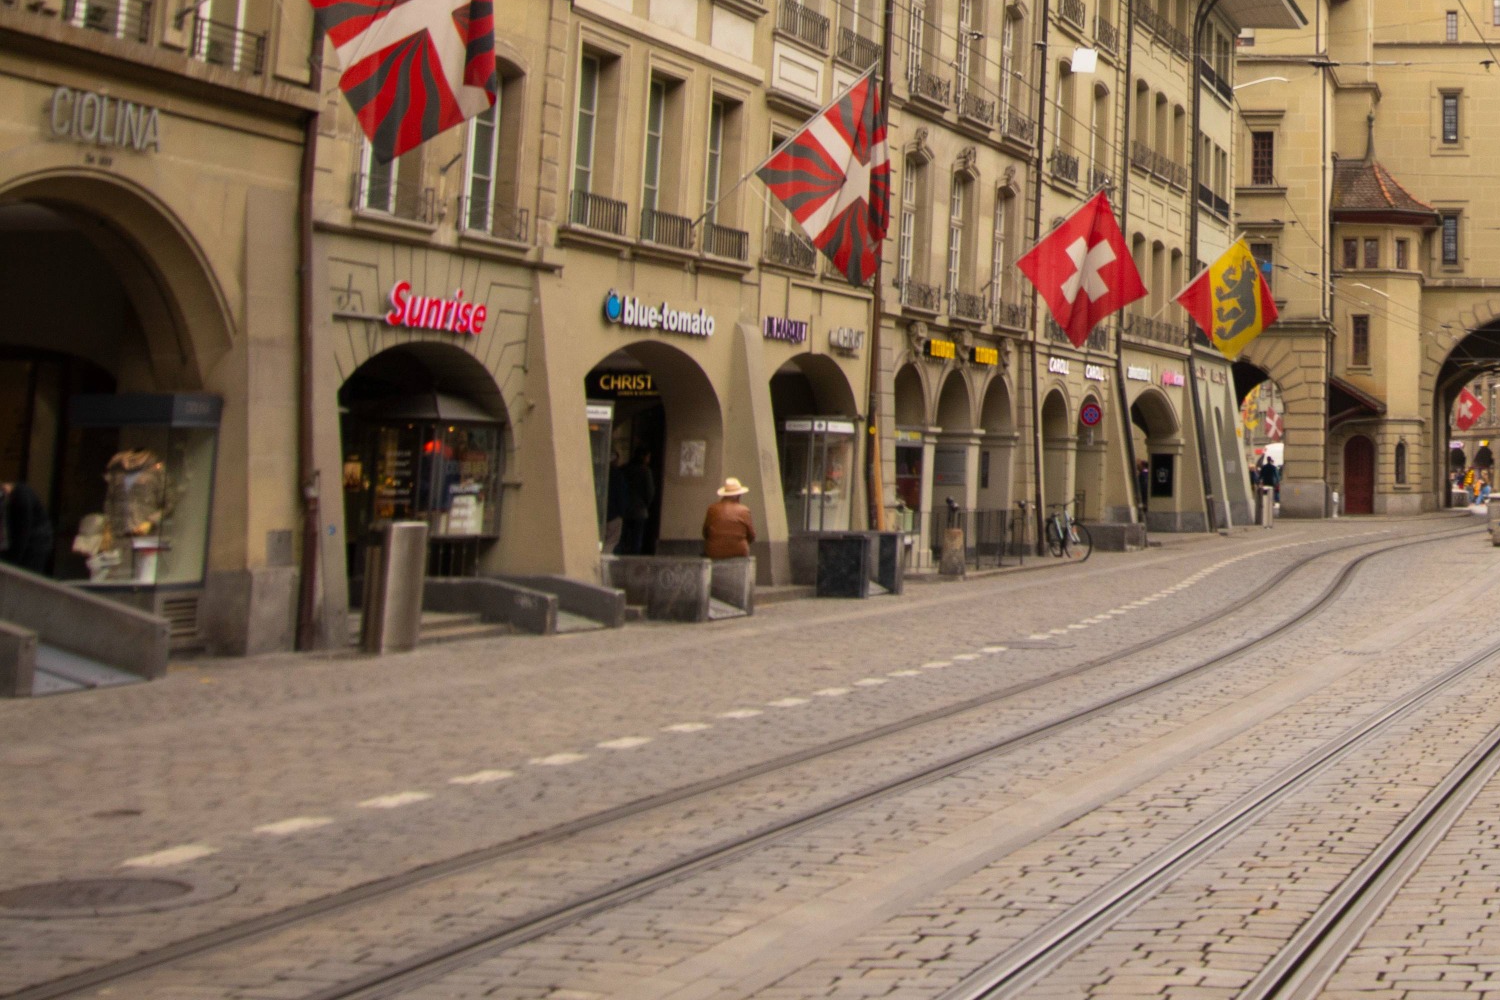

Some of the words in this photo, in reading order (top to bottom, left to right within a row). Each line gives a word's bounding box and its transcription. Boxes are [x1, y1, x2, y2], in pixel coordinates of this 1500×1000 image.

[51, 85, 161, 154] CIOLINA
[386, 280, 487, 335] Sunrise
[623, 295, 716, 336] blue-tomato
[600, 374, 653, 391] CHRIST
